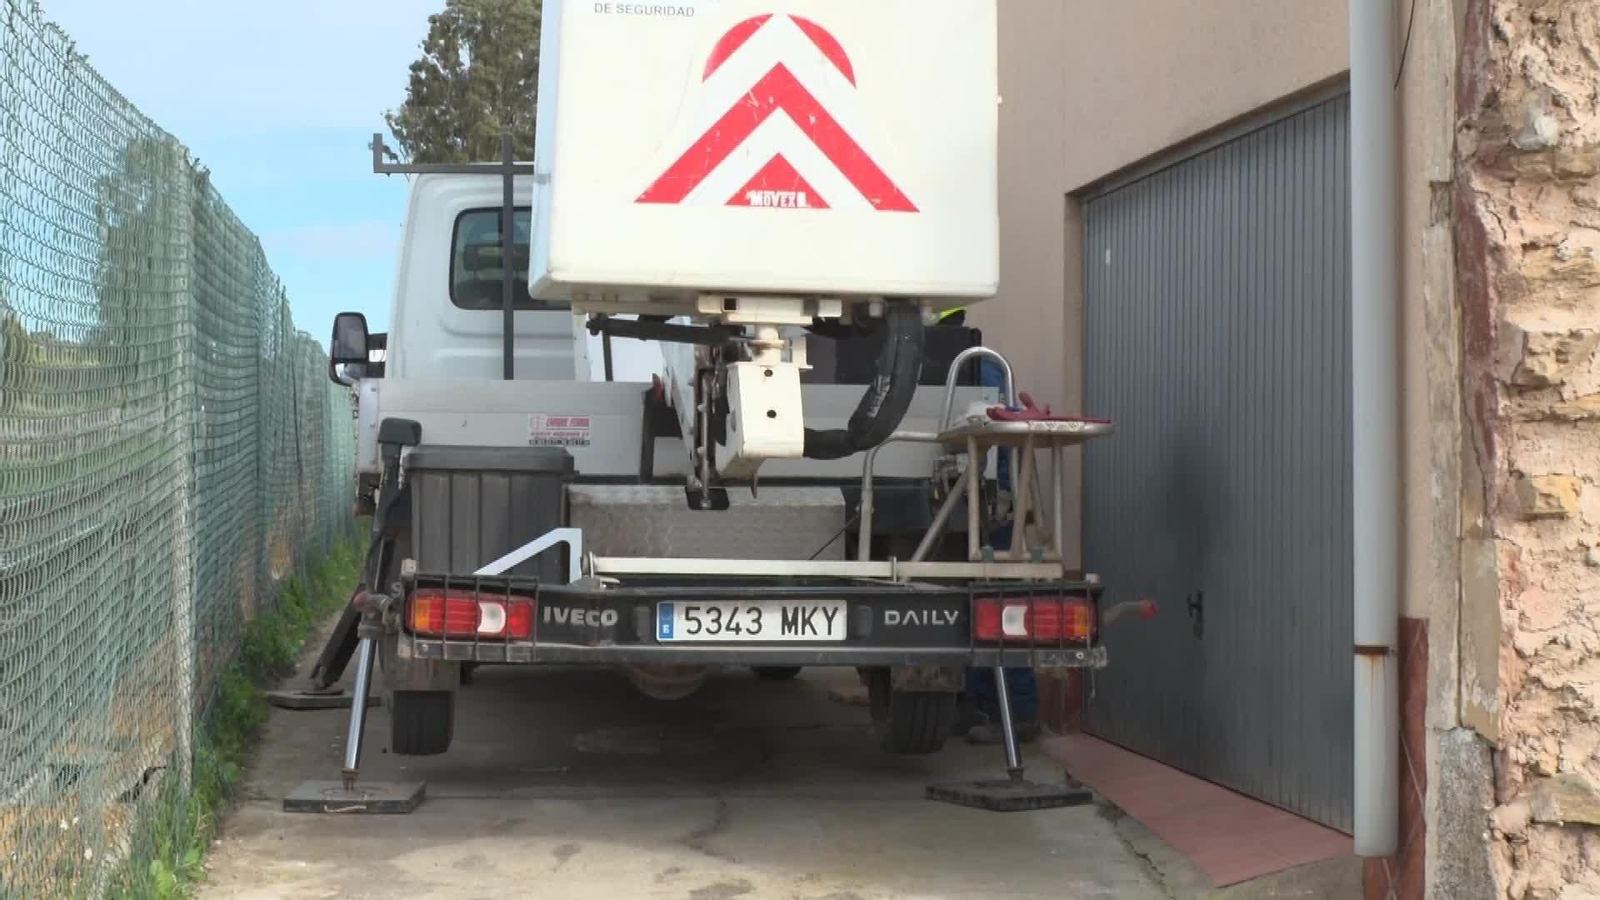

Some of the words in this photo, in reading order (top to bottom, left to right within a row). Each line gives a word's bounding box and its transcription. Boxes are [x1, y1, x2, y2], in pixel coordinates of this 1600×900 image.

[594, 2, 613, 14] DE
[616, 3, 695, 17] SEGURIDAD
[543, 606, 618, 626] IVECO
[684, 606, 763, 635] 5343
[780, 606, 840, 636] MKY
[884, 609, 960, 626] DAILY
